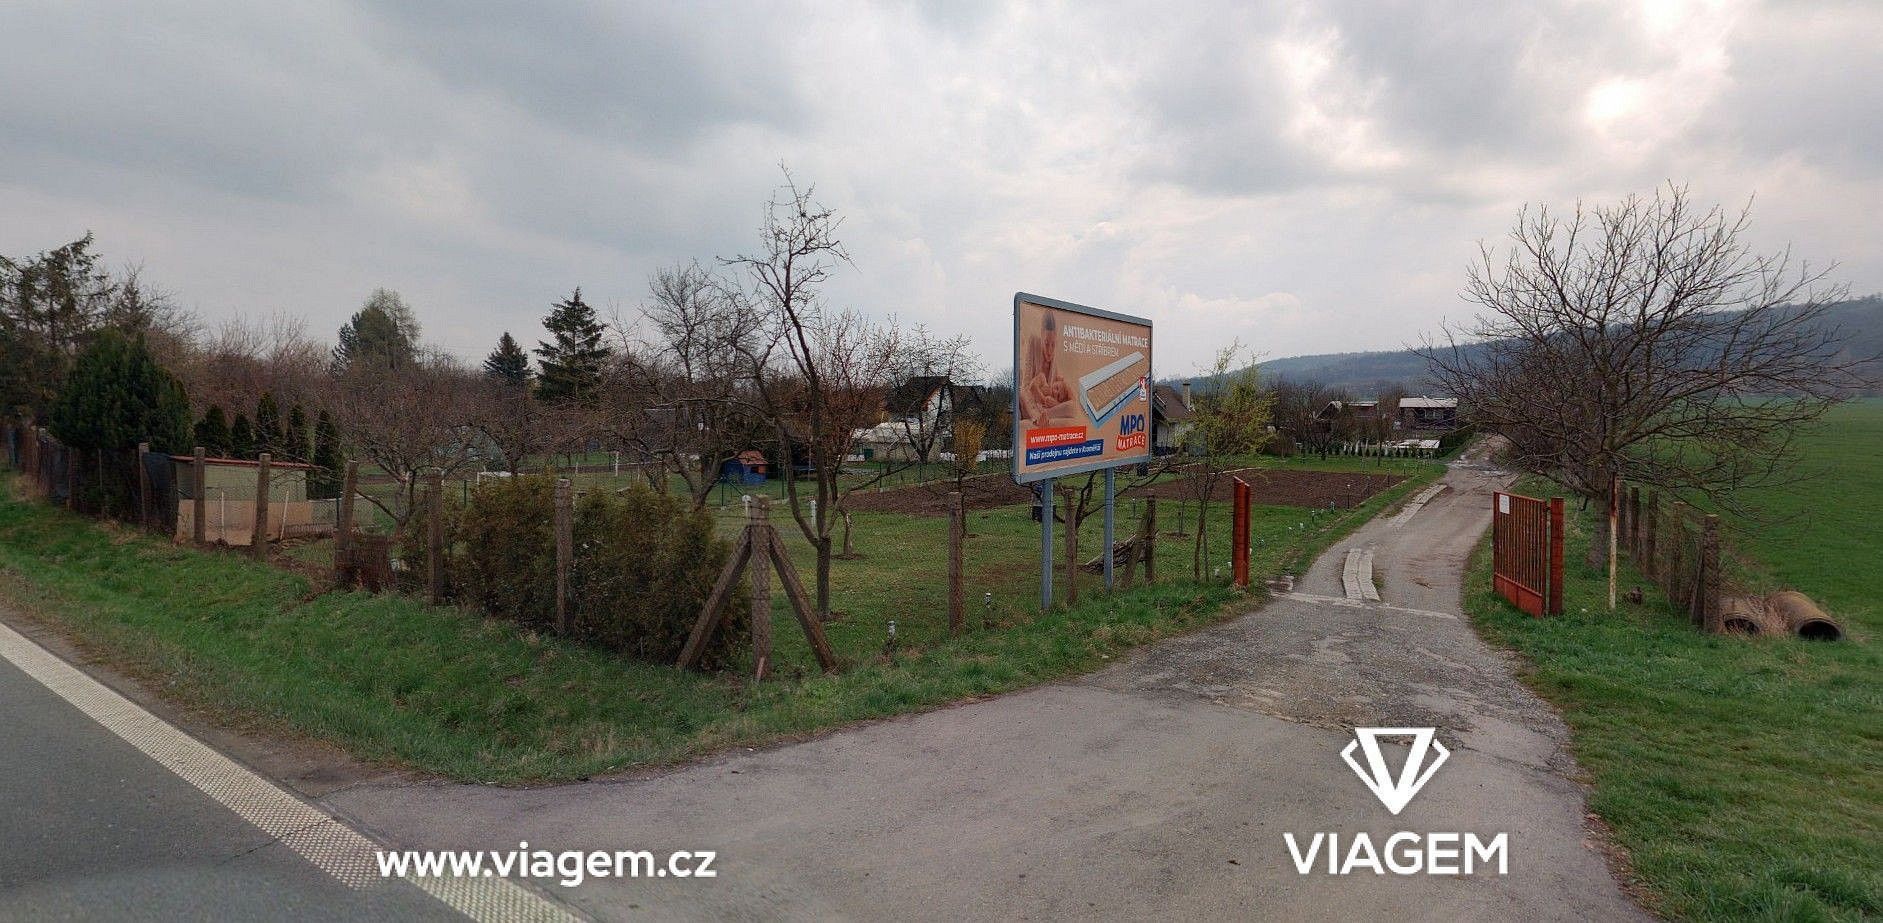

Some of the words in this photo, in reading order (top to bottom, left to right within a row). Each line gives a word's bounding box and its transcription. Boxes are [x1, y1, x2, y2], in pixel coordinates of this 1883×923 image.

[1063, 325, 1121, 344] ANTIBAKTERIÁLNÍ
[1122, 334, 1149, 348] MATRACE
[1063, 341, 1068, 352] S
[1120, 414, 1145, 435] MPO
[1030, 432, 1084, 444] www.mpo-matrace.cz
[1117, 435, 1146, 449] MATRACE
